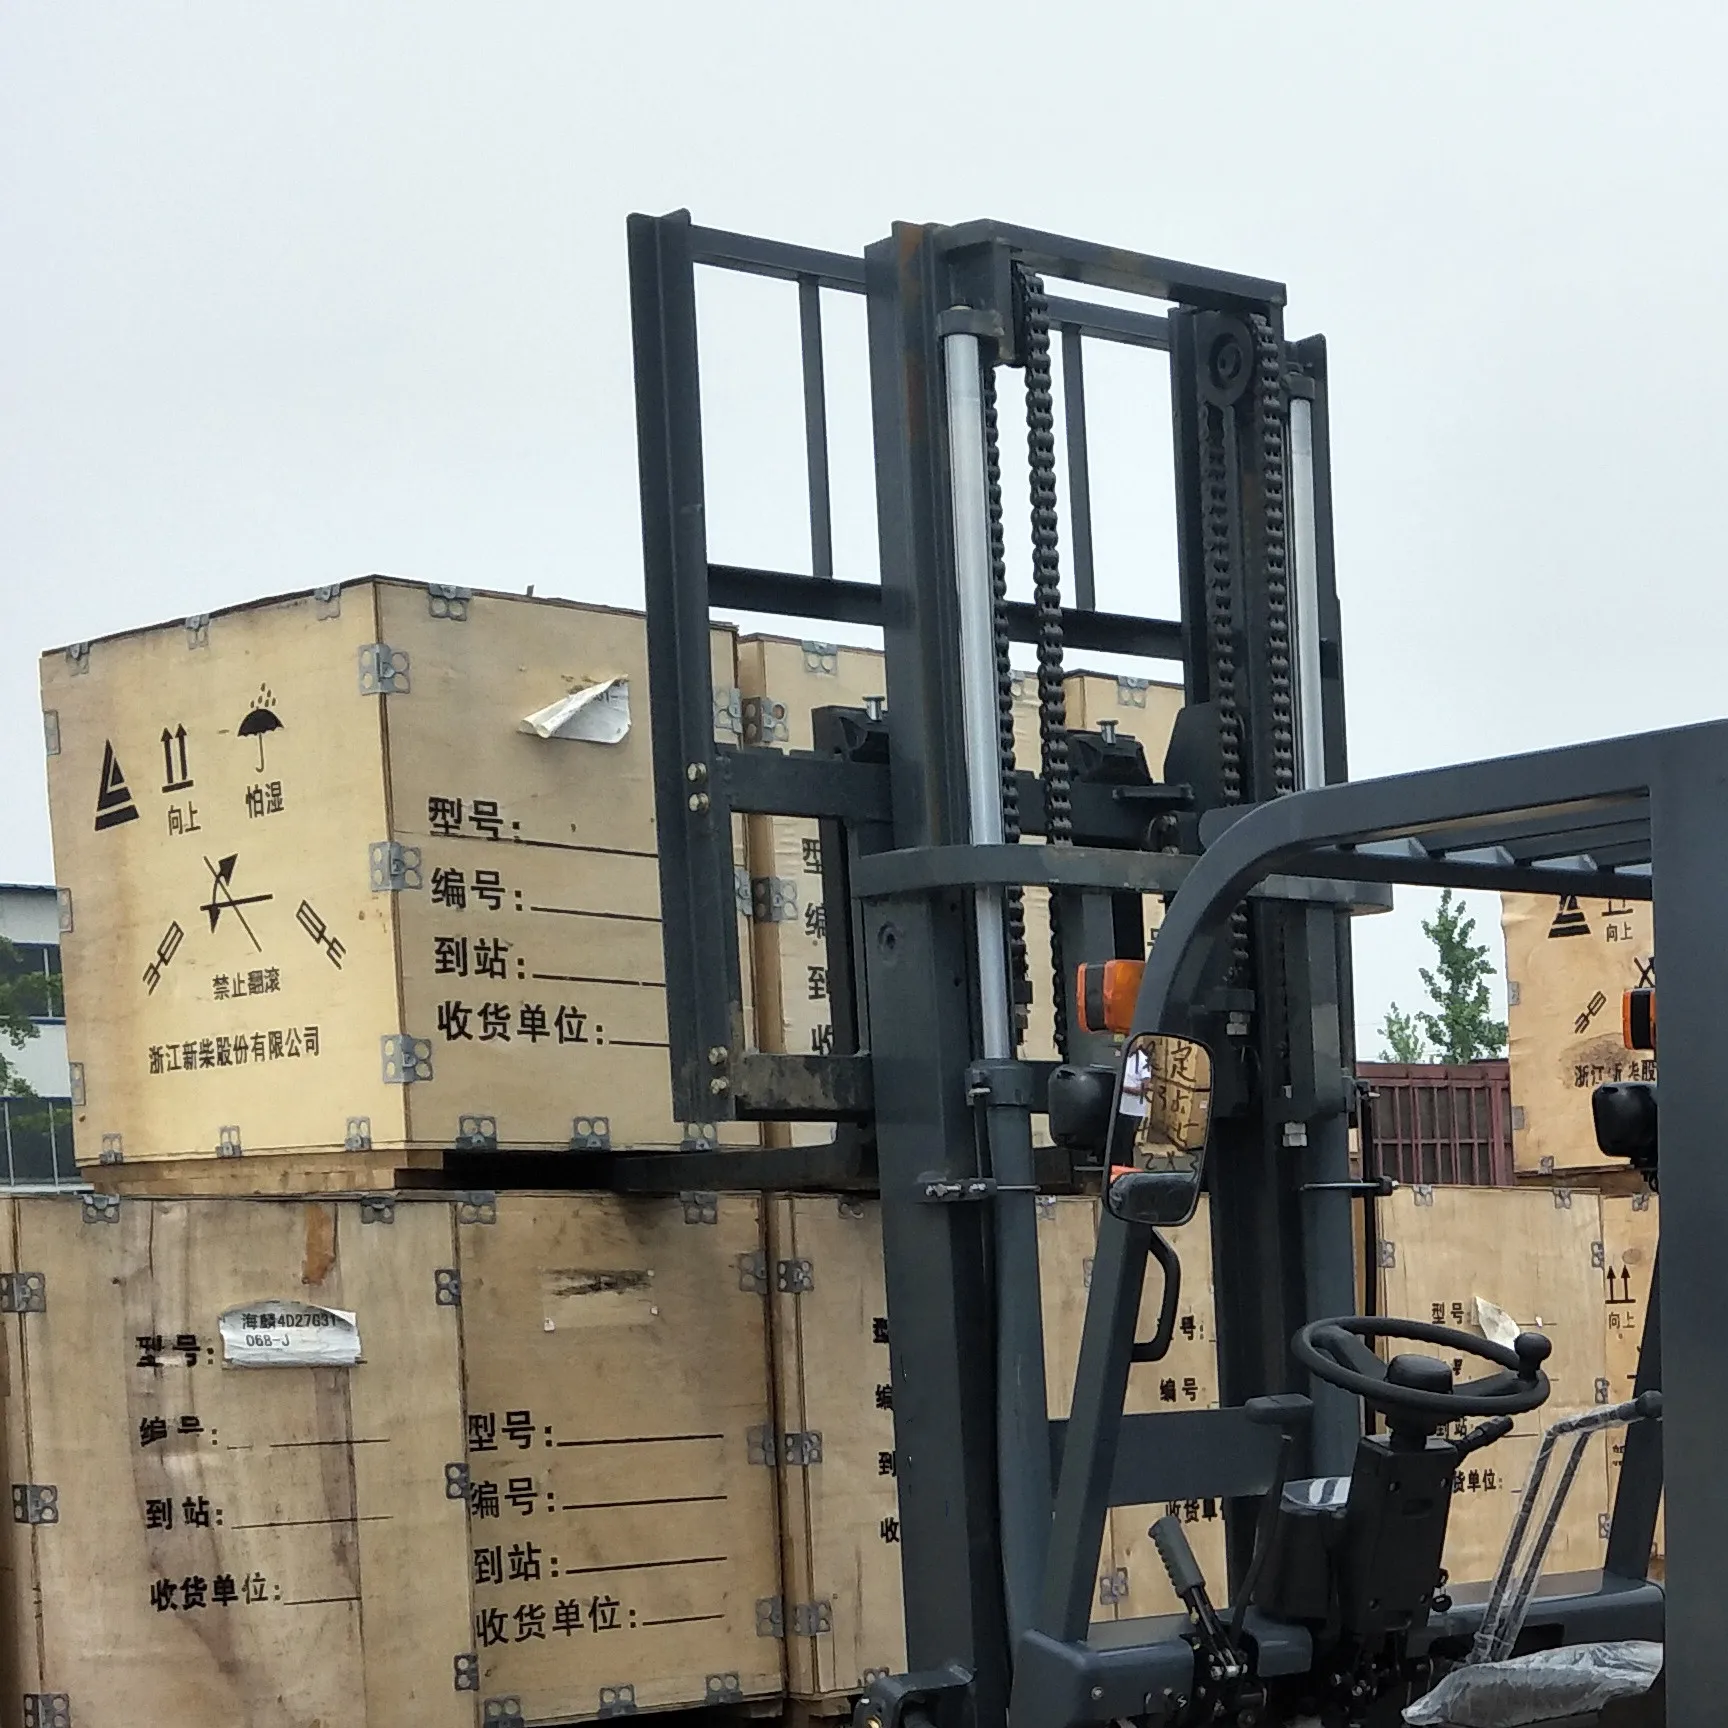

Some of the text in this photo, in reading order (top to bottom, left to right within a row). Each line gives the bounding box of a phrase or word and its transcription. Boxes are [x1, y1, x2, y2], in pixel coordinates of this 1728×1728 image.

[168, 801, 200, 836] 向上
[246, 781, 284, 818] 怕湿
[428, 797, 521, 843] 型号：
[430, 867, 522, 911] 编号：
[1605, 921, 1633, 942] 向上
[434, 937, 525, 980] 到站：
[212, 967, 281, 1000] 禁止翻滚
[438, 1000, 603, 1046] 收货单位：
[149, 1026, 321, 1074] 浙江新柴股份有限公司
[1608, 1311, 1635, 1330] 向上
[468, 1410, 553, 1453] 型号：
[145, 1496, 223, 1530] 到站：
[470, 1477, 555, 1519] 编号：
[474, 1541, 559, 1585] 到站：
[150, 1571, 281, 1612] 收货单位：
[476, 1595, 637, 1647] 收货单位：
